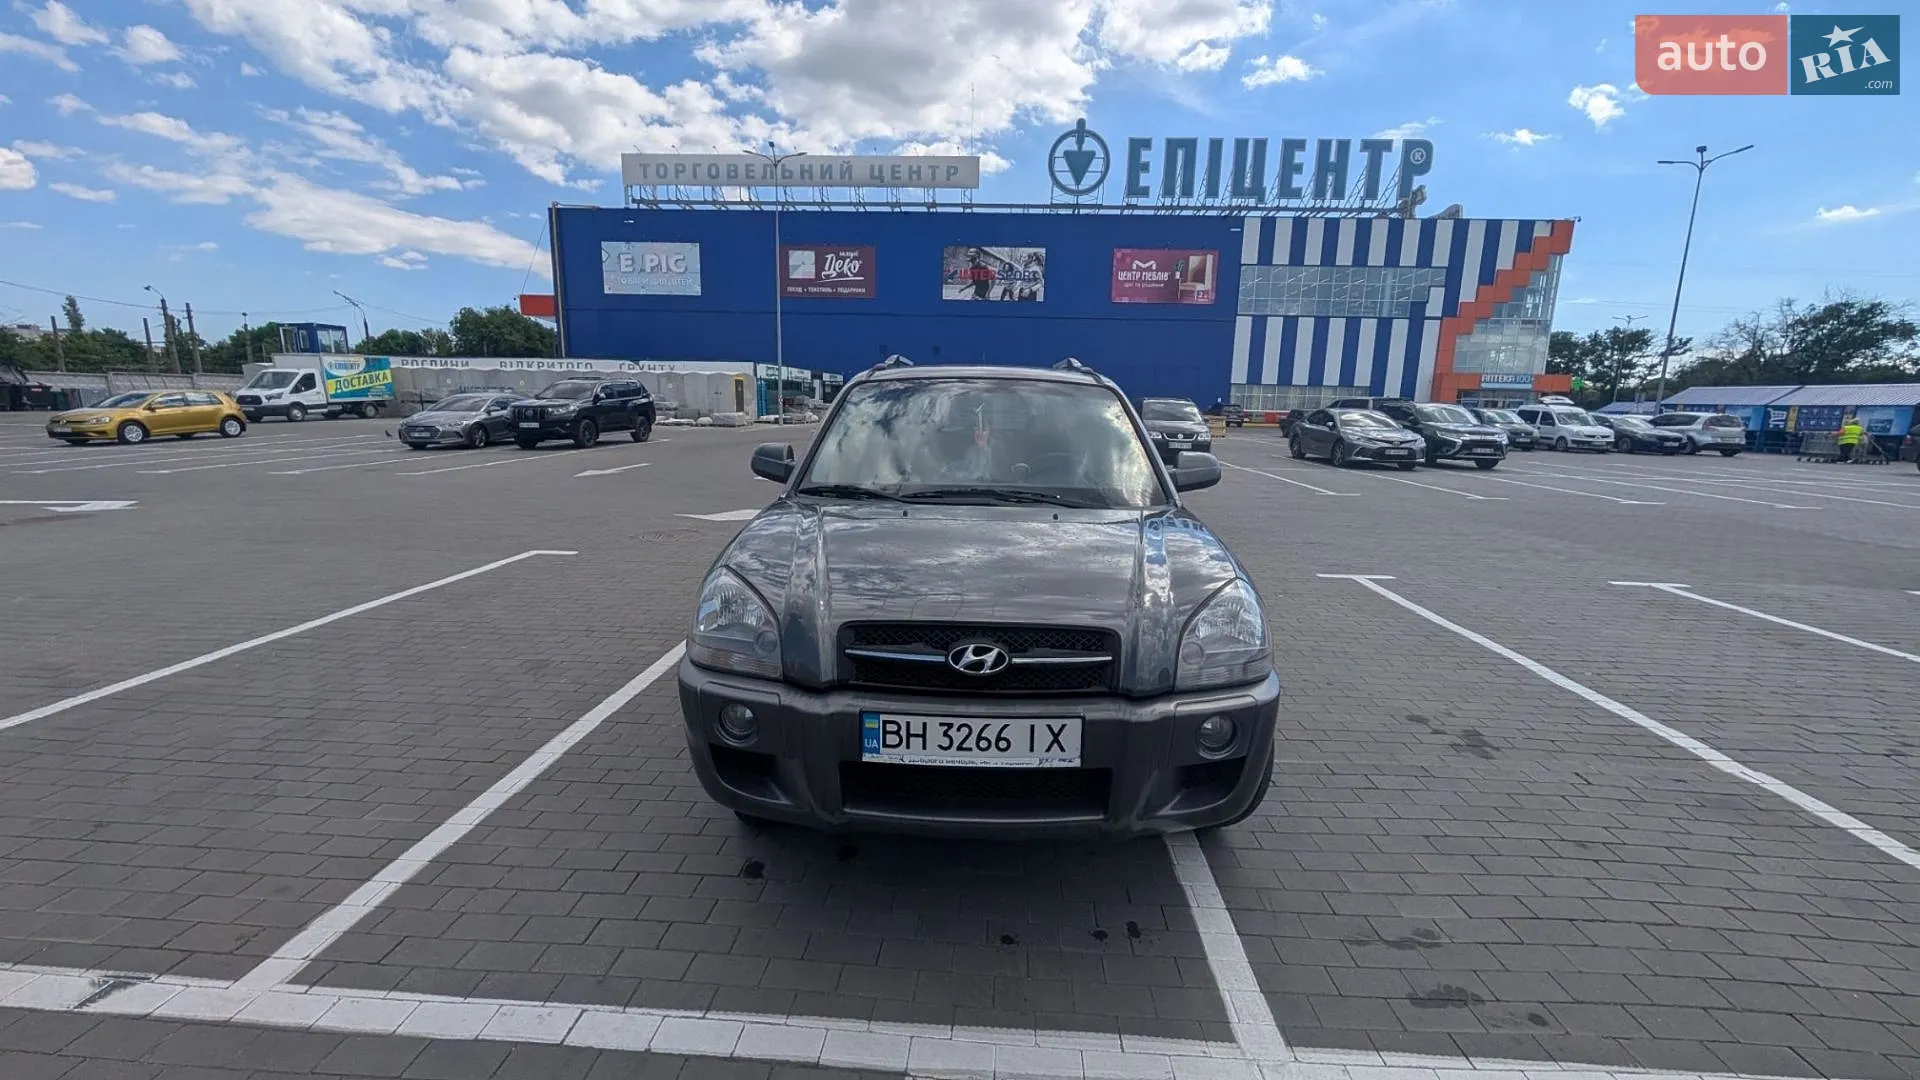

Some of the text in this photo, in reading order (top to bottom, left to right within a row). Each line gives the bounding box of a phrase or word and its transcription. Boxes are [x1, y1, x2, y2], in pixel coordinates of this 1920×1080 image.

[639, 160, 960, 184] ТОРГОВЕЛЬНИЙ ЦЕНТР
[1125, 137, 1433, 205] ЕПІЦЕНТР
[1118, 271, 1141, 281] ЦЕНТР
[335, 372, 389, 393] ДОСТАВКА
[864, 739, 880, 749] UA
[881, 719, 1068, 753] BH 3266 IX
